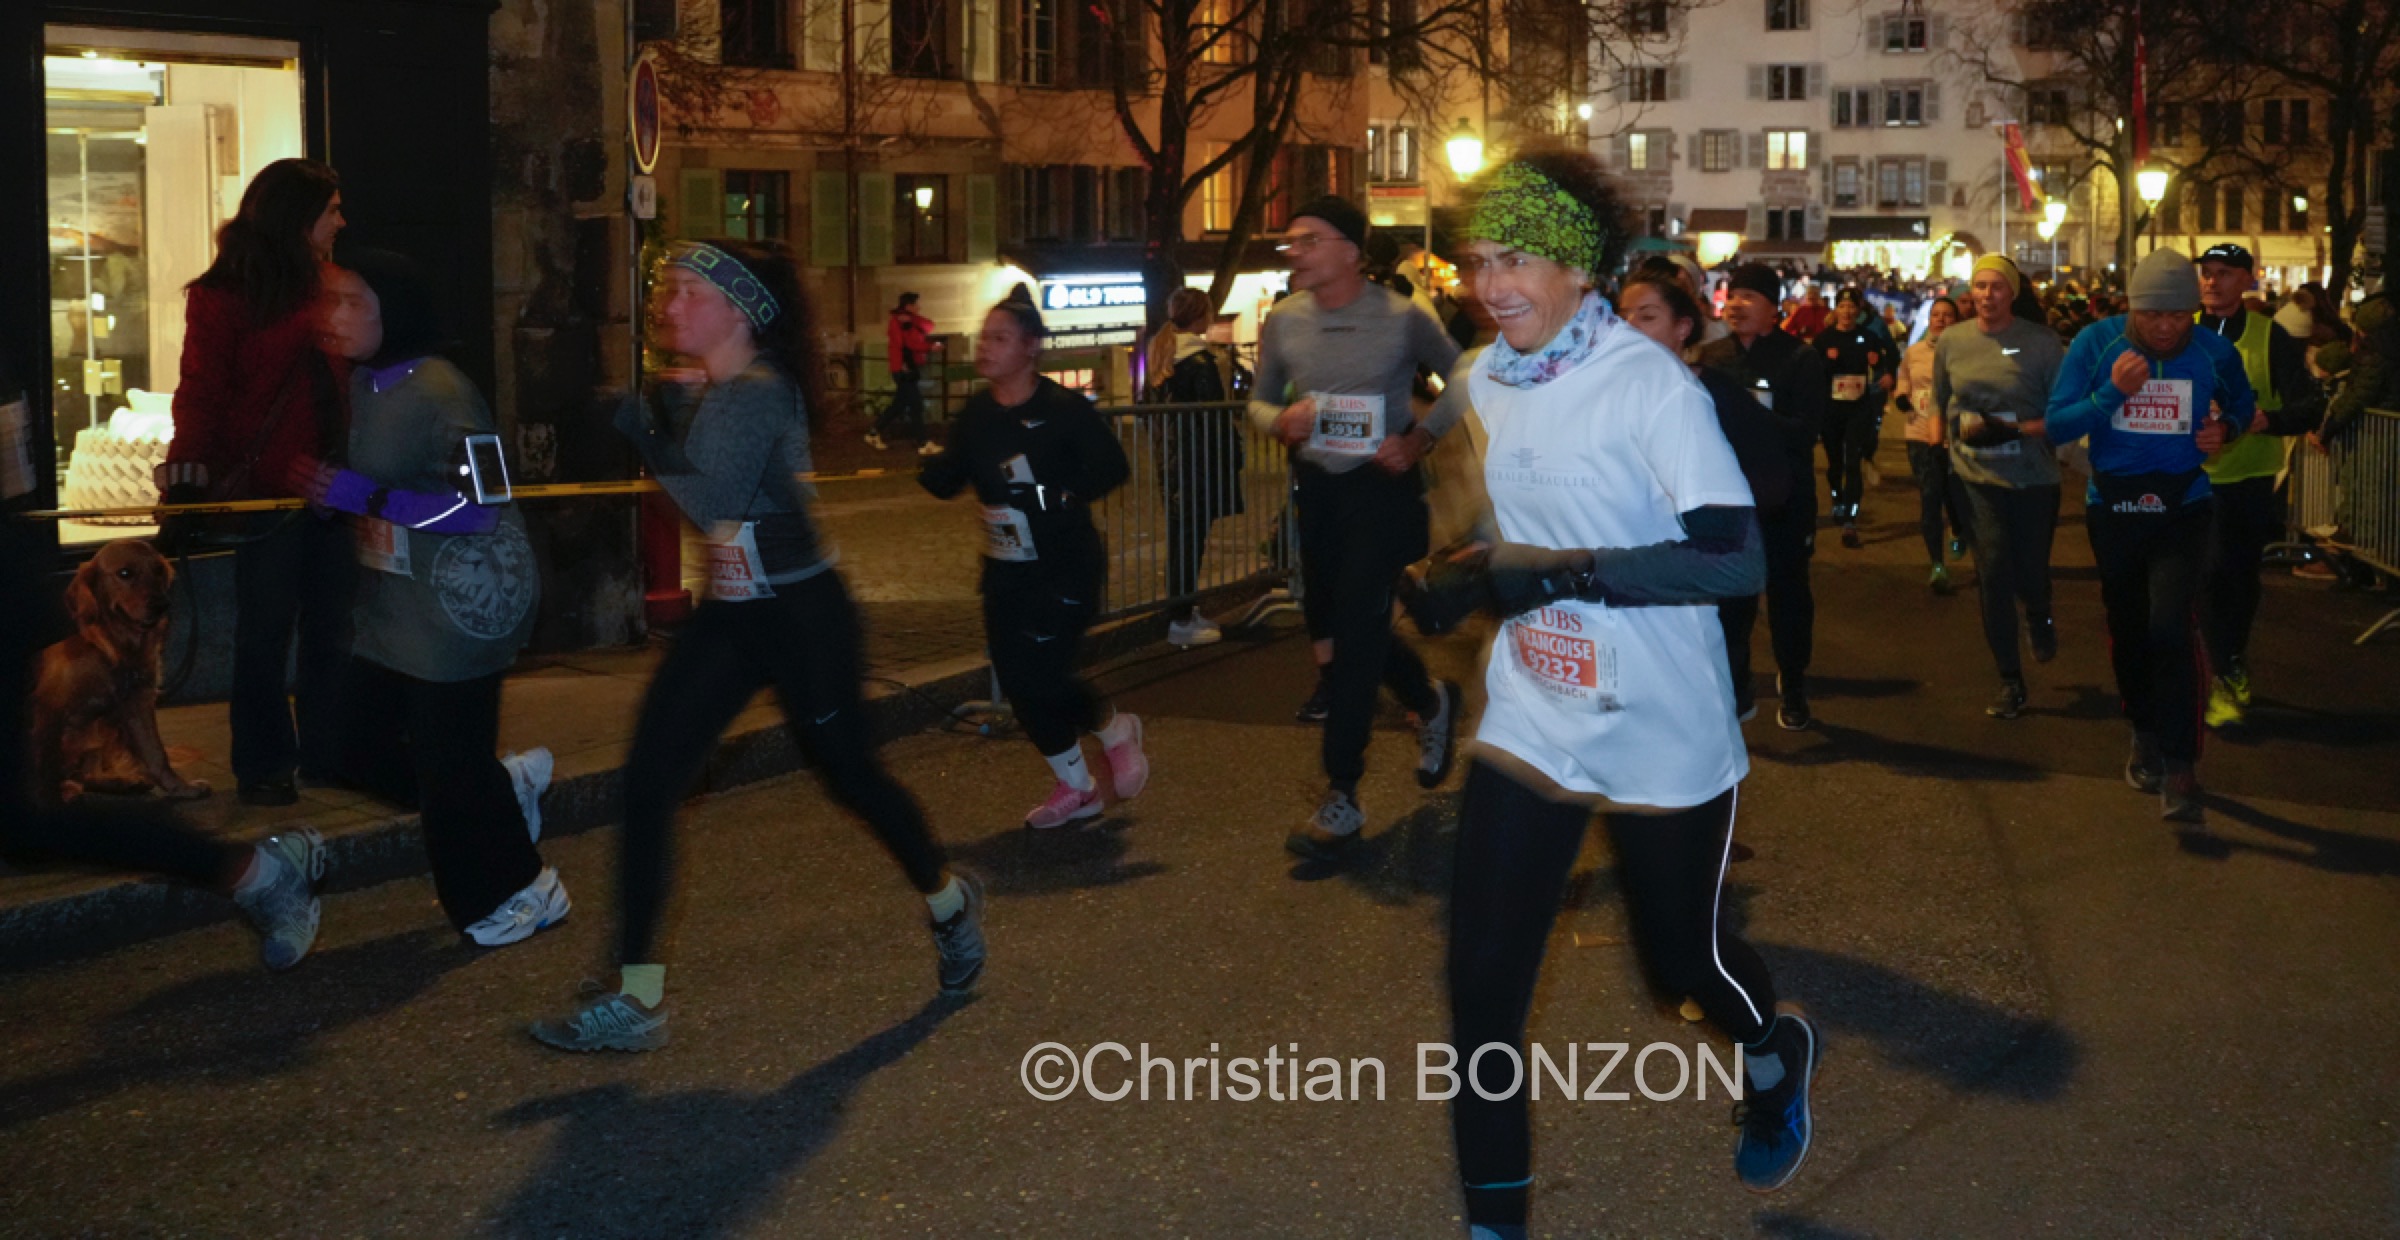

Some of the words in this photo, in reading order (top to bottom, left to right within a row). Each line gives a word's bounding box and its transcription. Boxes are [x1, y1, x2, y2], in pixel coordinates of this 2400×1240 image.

[2127, 406, 2175, 419] 37810
[1327, 423, 1363, 438] 5934
[2129, 421, 2173, 431] MIGROS
[1325, 438, 1366, 451] MIGROS
[1541, 607, 1583, 633] UBS
[1527, 648, 1581, 684] 9232
